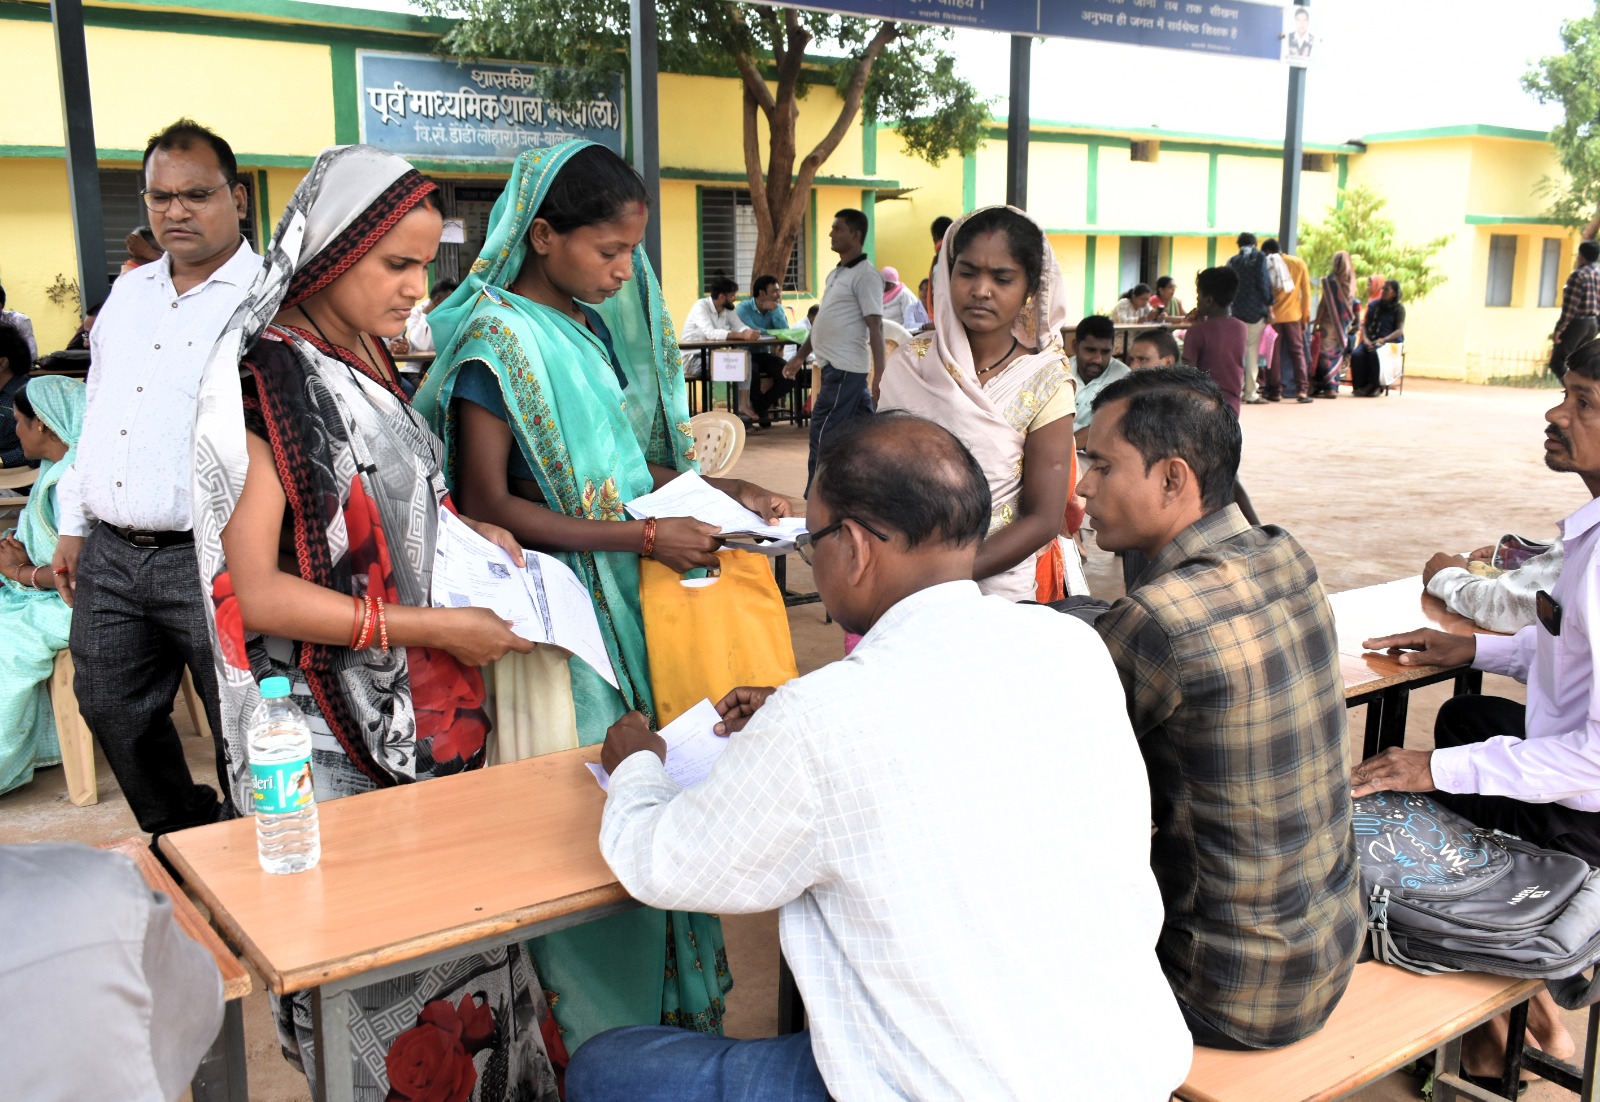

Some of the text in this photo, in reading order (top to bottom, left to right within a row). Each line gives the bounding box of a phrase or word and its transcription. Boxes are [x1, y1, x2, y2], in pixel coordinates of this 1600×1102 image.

[1081, 10, 1114, 26] अनुभव
[1116, 12, 1127, 26] ही
[1129, 16, 1154, 28] जगत
[471, 68, 535, 90] शासकीय
[365, 81, 407, 126] पूर्व
[408, 86, 499, 122] माध्यमिक
